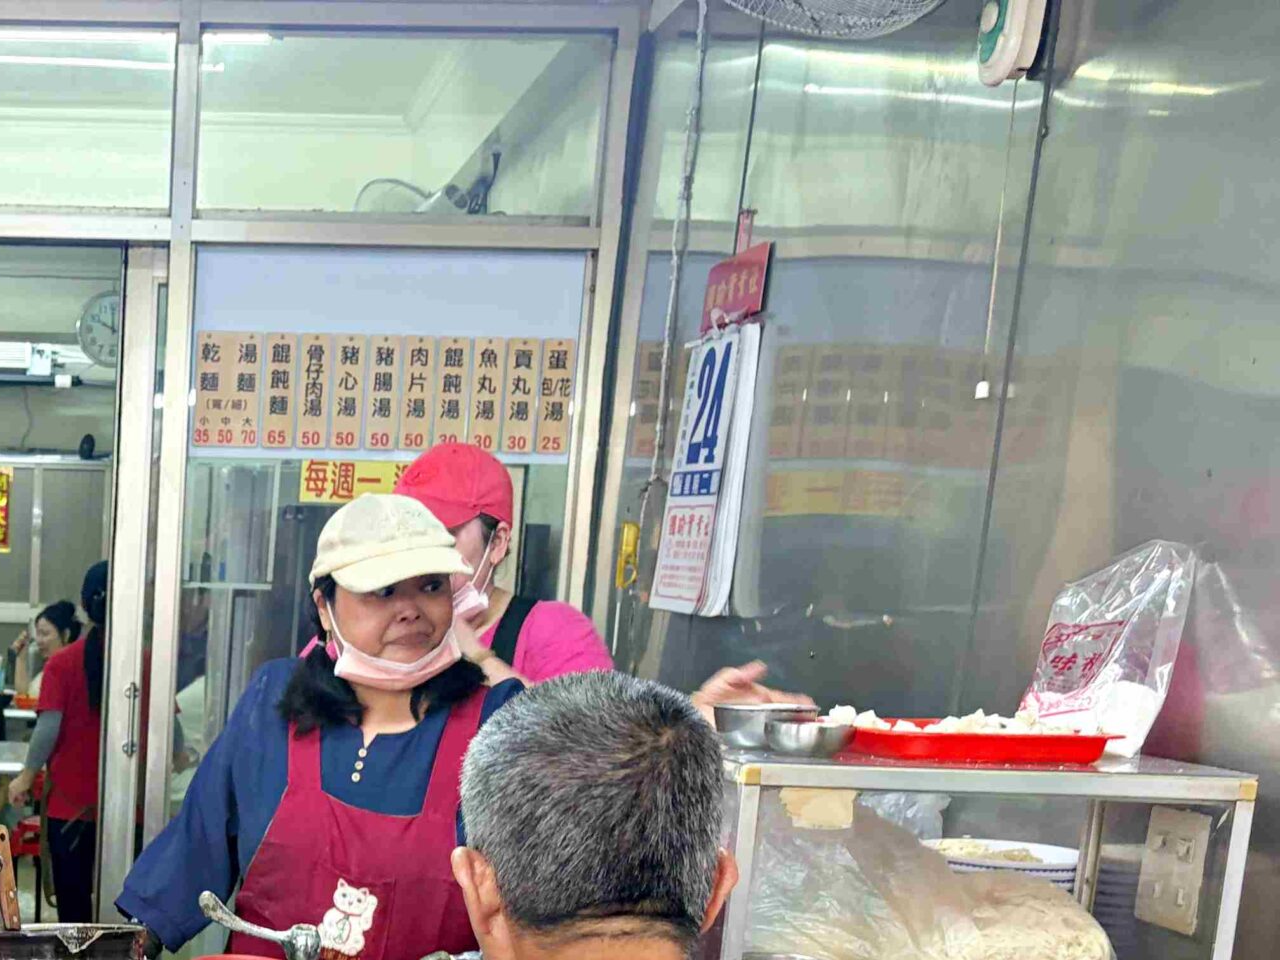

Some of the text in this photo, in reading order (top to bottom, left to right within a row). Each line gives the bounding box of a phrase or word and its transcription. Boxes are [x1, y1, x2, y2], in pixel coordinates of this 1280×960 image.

[201, 343, 220, 391] 乾麵
[237, 343, 257, 392] 湯麵
[269, 343, 291, 415] 餛飩麵
[303, 344, 324, 417] 骨仔肉湯
[337, 345, 359, 416] 豬心湯
[372, 346, 394, 418] 豬腸湯
[406, 346, 428, 418] 肉片湯
[440, 347, 463, 420] 餛飩湯
[475, 348, 497, 420] 魚丸湯
[509, 349, 533, 421] 貢丸湯
[221, 416, 231, 426] 中
[243, 417, 252, 427] 大
[687, 341, 732, 465] 24
[195, 429, 256, 444] 35 50 70
[267, 430, 286, 444] 65
[302, 431, 320, 445] 50
[335, 432, 354, 446] 50
[370, 432, 389, 447] 50
[404, 433, 423, 447] 50
[507, 435, 526, 450] 30
[541, 436, 561, 451] 25
[303, 461, 382, 500] 每週一
